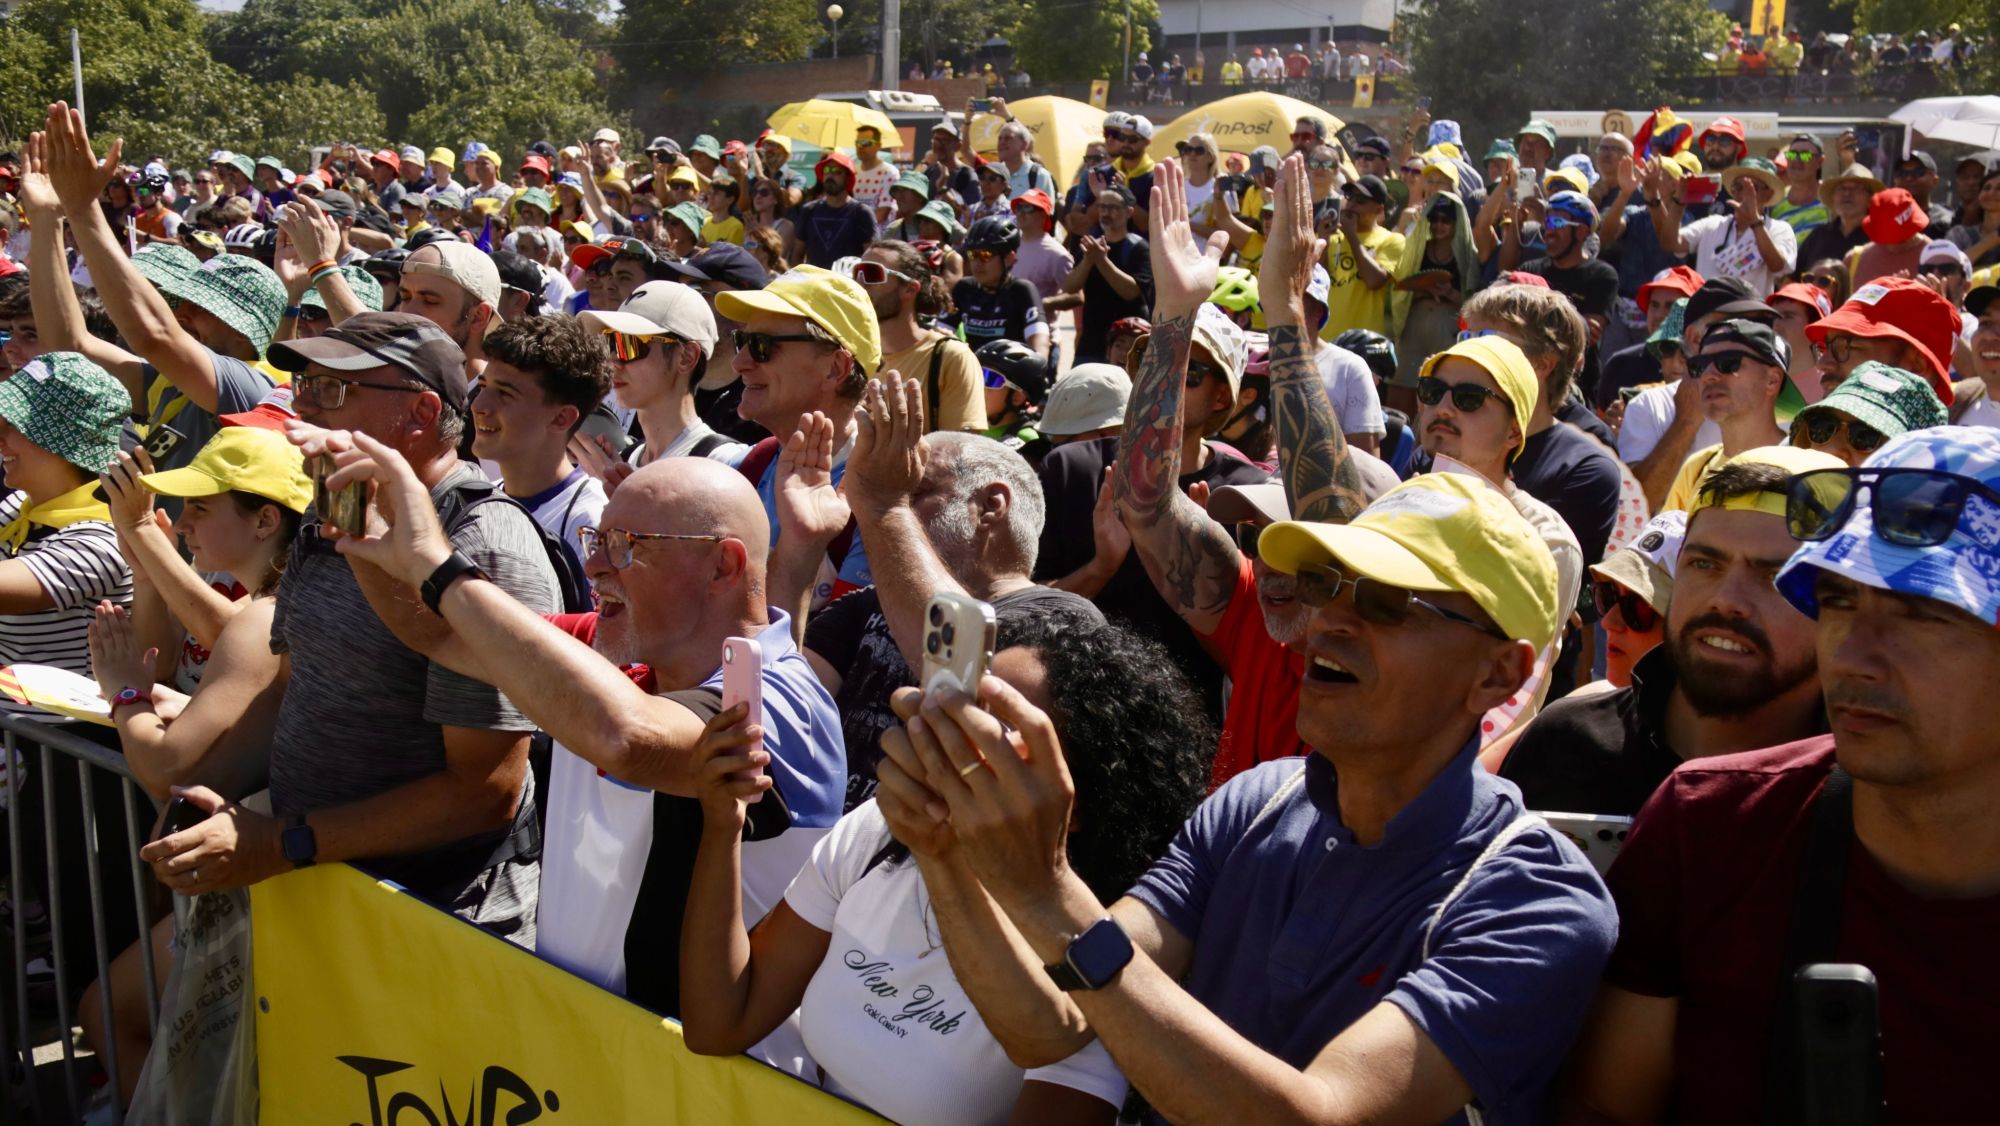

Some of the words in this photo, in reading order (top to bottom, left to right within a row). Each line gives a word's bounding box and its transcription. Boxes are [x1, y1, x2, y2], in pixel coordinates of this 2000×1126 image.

[1212, 119, 1274, 136] InPost
[1610, 120, 1625, 132] 21
[968, 319, 1007, 327] SCOTT
[29, 383, 52, 401] JULES
[45, 386, 69, 405] JULES
[61, 389, 87, 407] JULES
[50, 402, 77, 420] JULES
[40, 413, 60, 438] JULES
[40, 428, 60, 454] JULES
[56, 422, 76, 448] JULES
[1644, 535, 1659, 548] 21
[203, 955, 240, 988] HETS
[844, 949, 899, 998] New
[891, 984, 967, 1035] York
